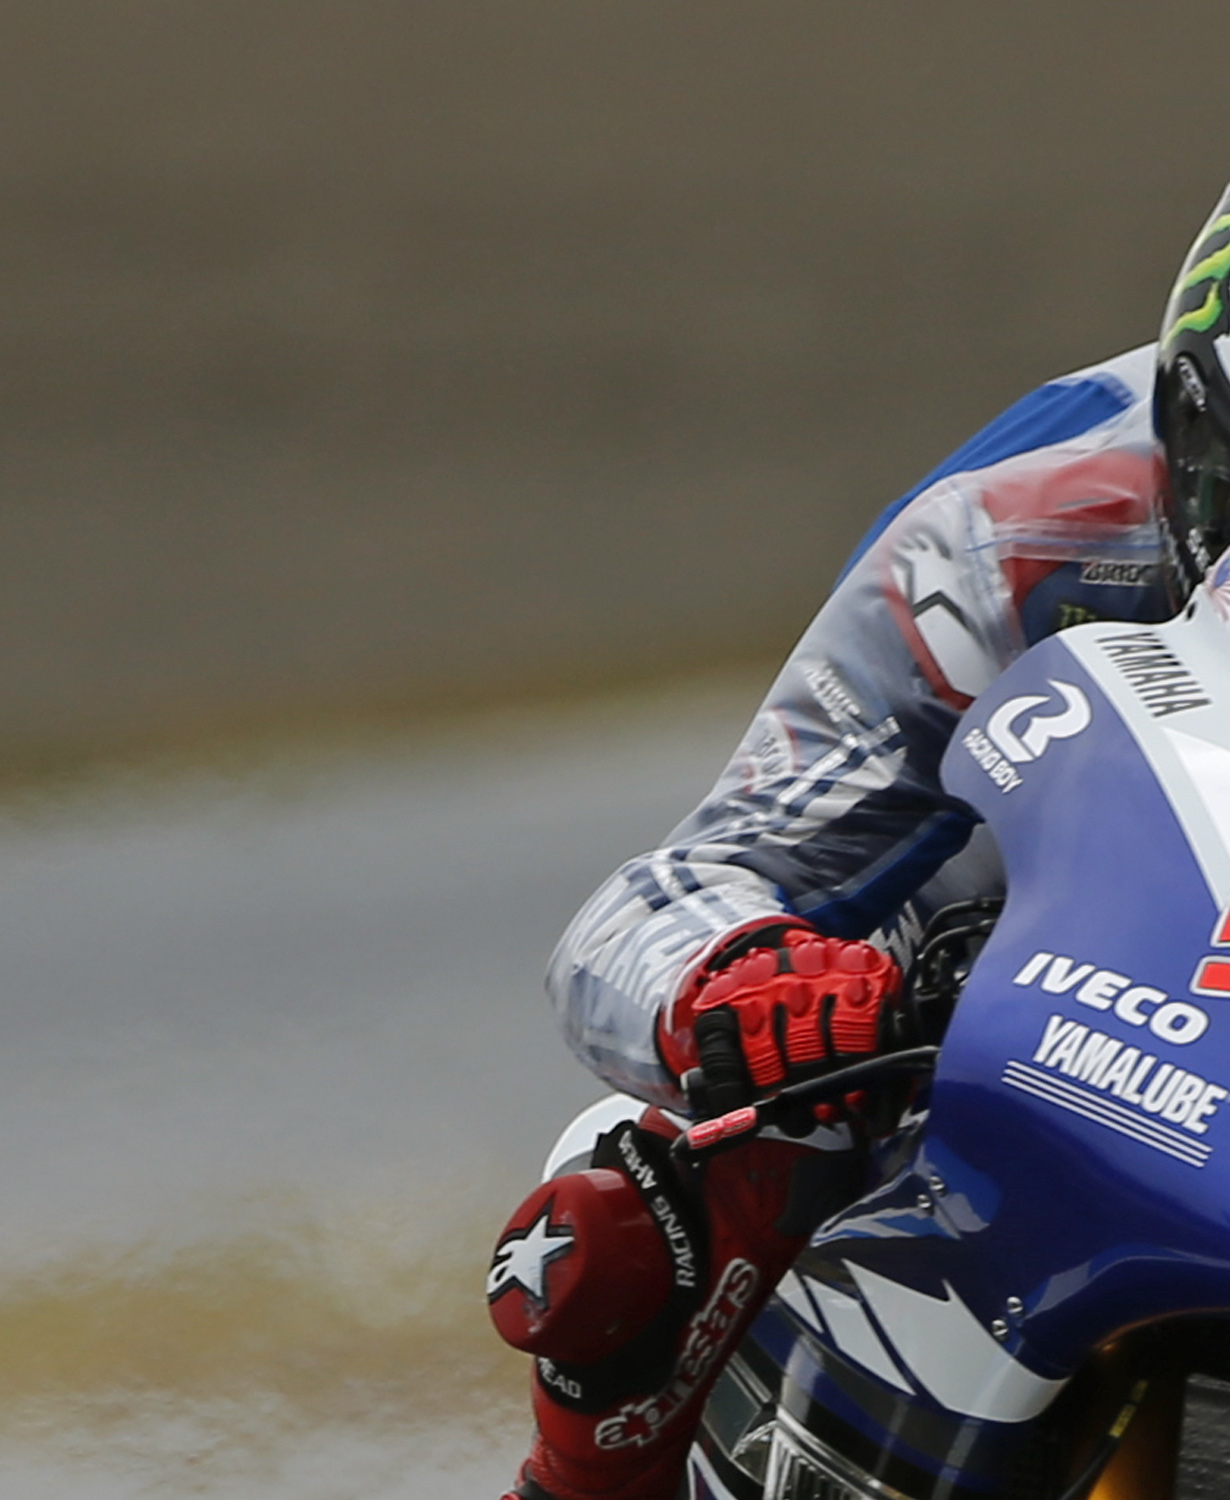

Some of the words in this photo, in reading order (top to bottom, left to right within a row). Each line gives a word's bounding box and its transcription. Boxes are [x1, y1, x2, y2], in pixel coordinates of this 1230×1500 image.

[1096, 632, 1210, 719] YAMAHA
[1012, 951, 1210, 1045] IVECO
[1032, 1013, 1230, 1135] YAMALUBE
[651, 1195, 697, 1288] RACING
